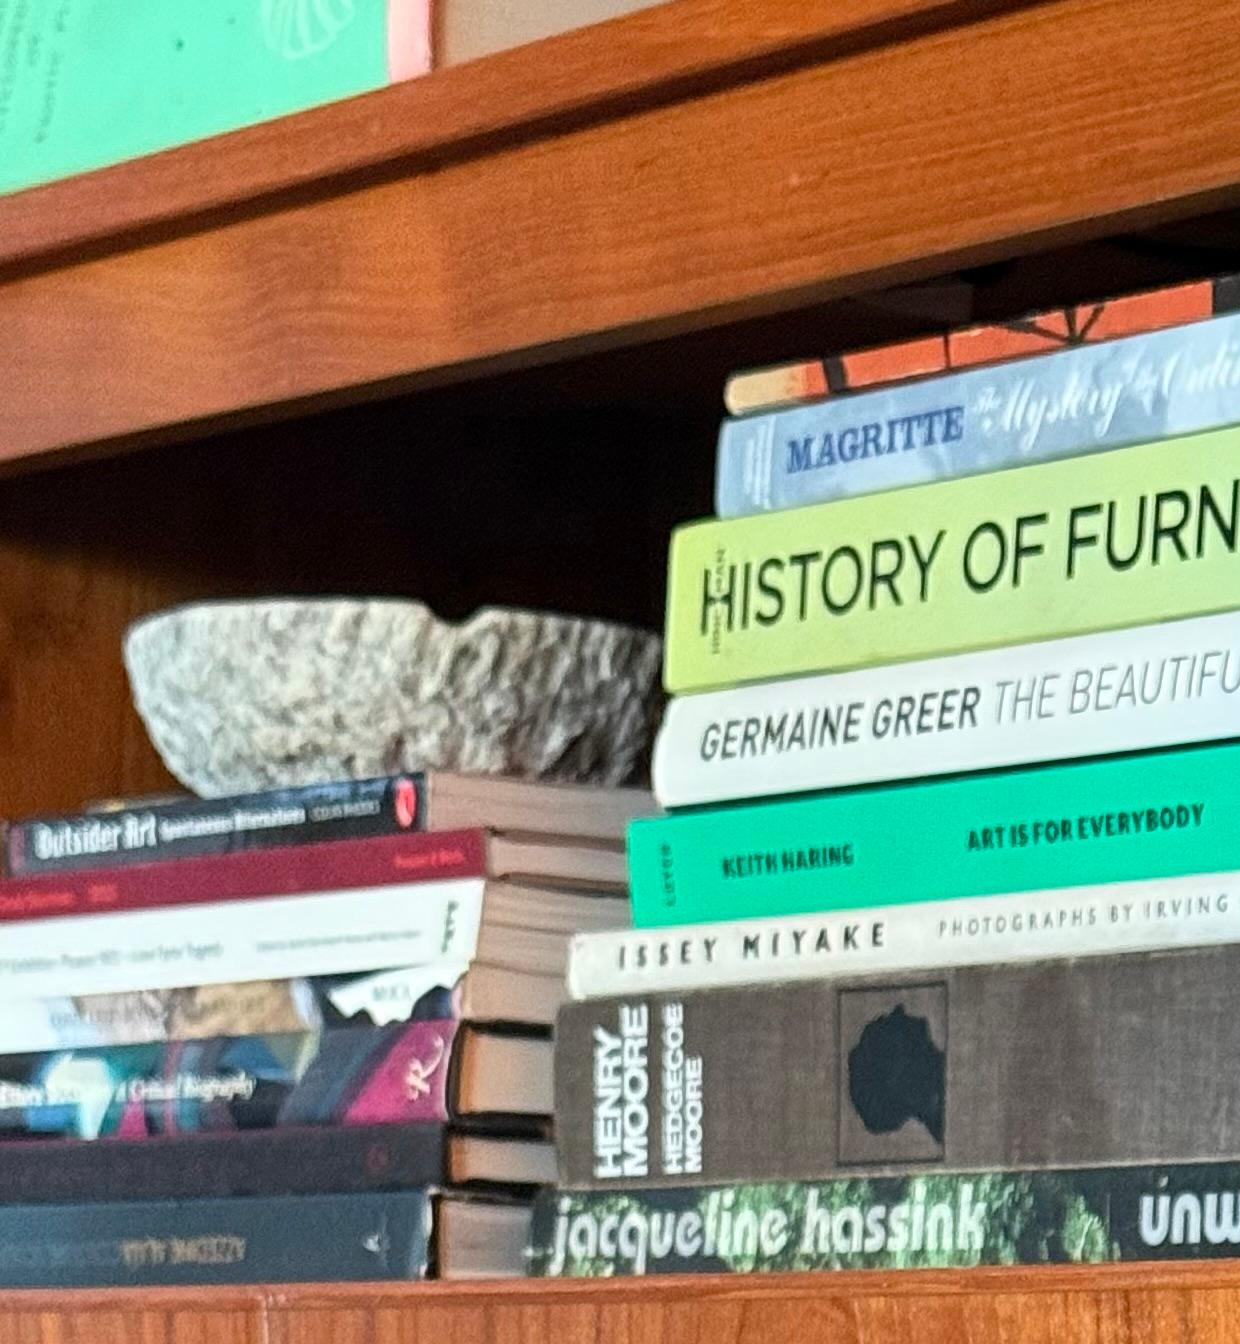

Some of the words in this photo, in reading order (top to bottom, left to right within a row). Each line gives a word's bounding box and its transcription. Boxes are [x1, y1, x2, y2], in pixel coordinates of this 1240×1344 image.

[787, 406, 965, 474] MAGRITTE
[701, 529, 947, 636] HISTORY
[963, 512, 1049, 594] OF
[699, 701, 866, 762] GERMAINE
[871, 686, 982, 740] GREER
[995, 672, 1062, 725] THE
[32, 822, 119, 859] Outsider
[121, 813, 158, 850] Art
[721, 852, 778, 880] KEITH
[781, 843, 855, 877] HARING
[967, 826, 1006, 851] ART
[1010, 824, 1029, 847] IS
[1032, 819, 1073, 845] FOR
[1077, 803, 1205, 839] EVERYBODY
[616, 937, 719, 971] ISSEY
[743, 922, 886, 960] MIYAKE
[938, 907, 1098, 938] PHOTOGRAPHS
[1110, 903, 1133, 924] BY
[1144, 894, 1230, 919] IRVING
[593, 1024, 622, 1180] HENRY
[619, 1003, 649, 1178] MOORE
[662, 1002, 684, 1175] HEDGECOE
[684, 1055, 703, 1174] MOORE
[548, 1188, 789, 1276] jacqueline
[801, 1182, 985, 1252] hassink
